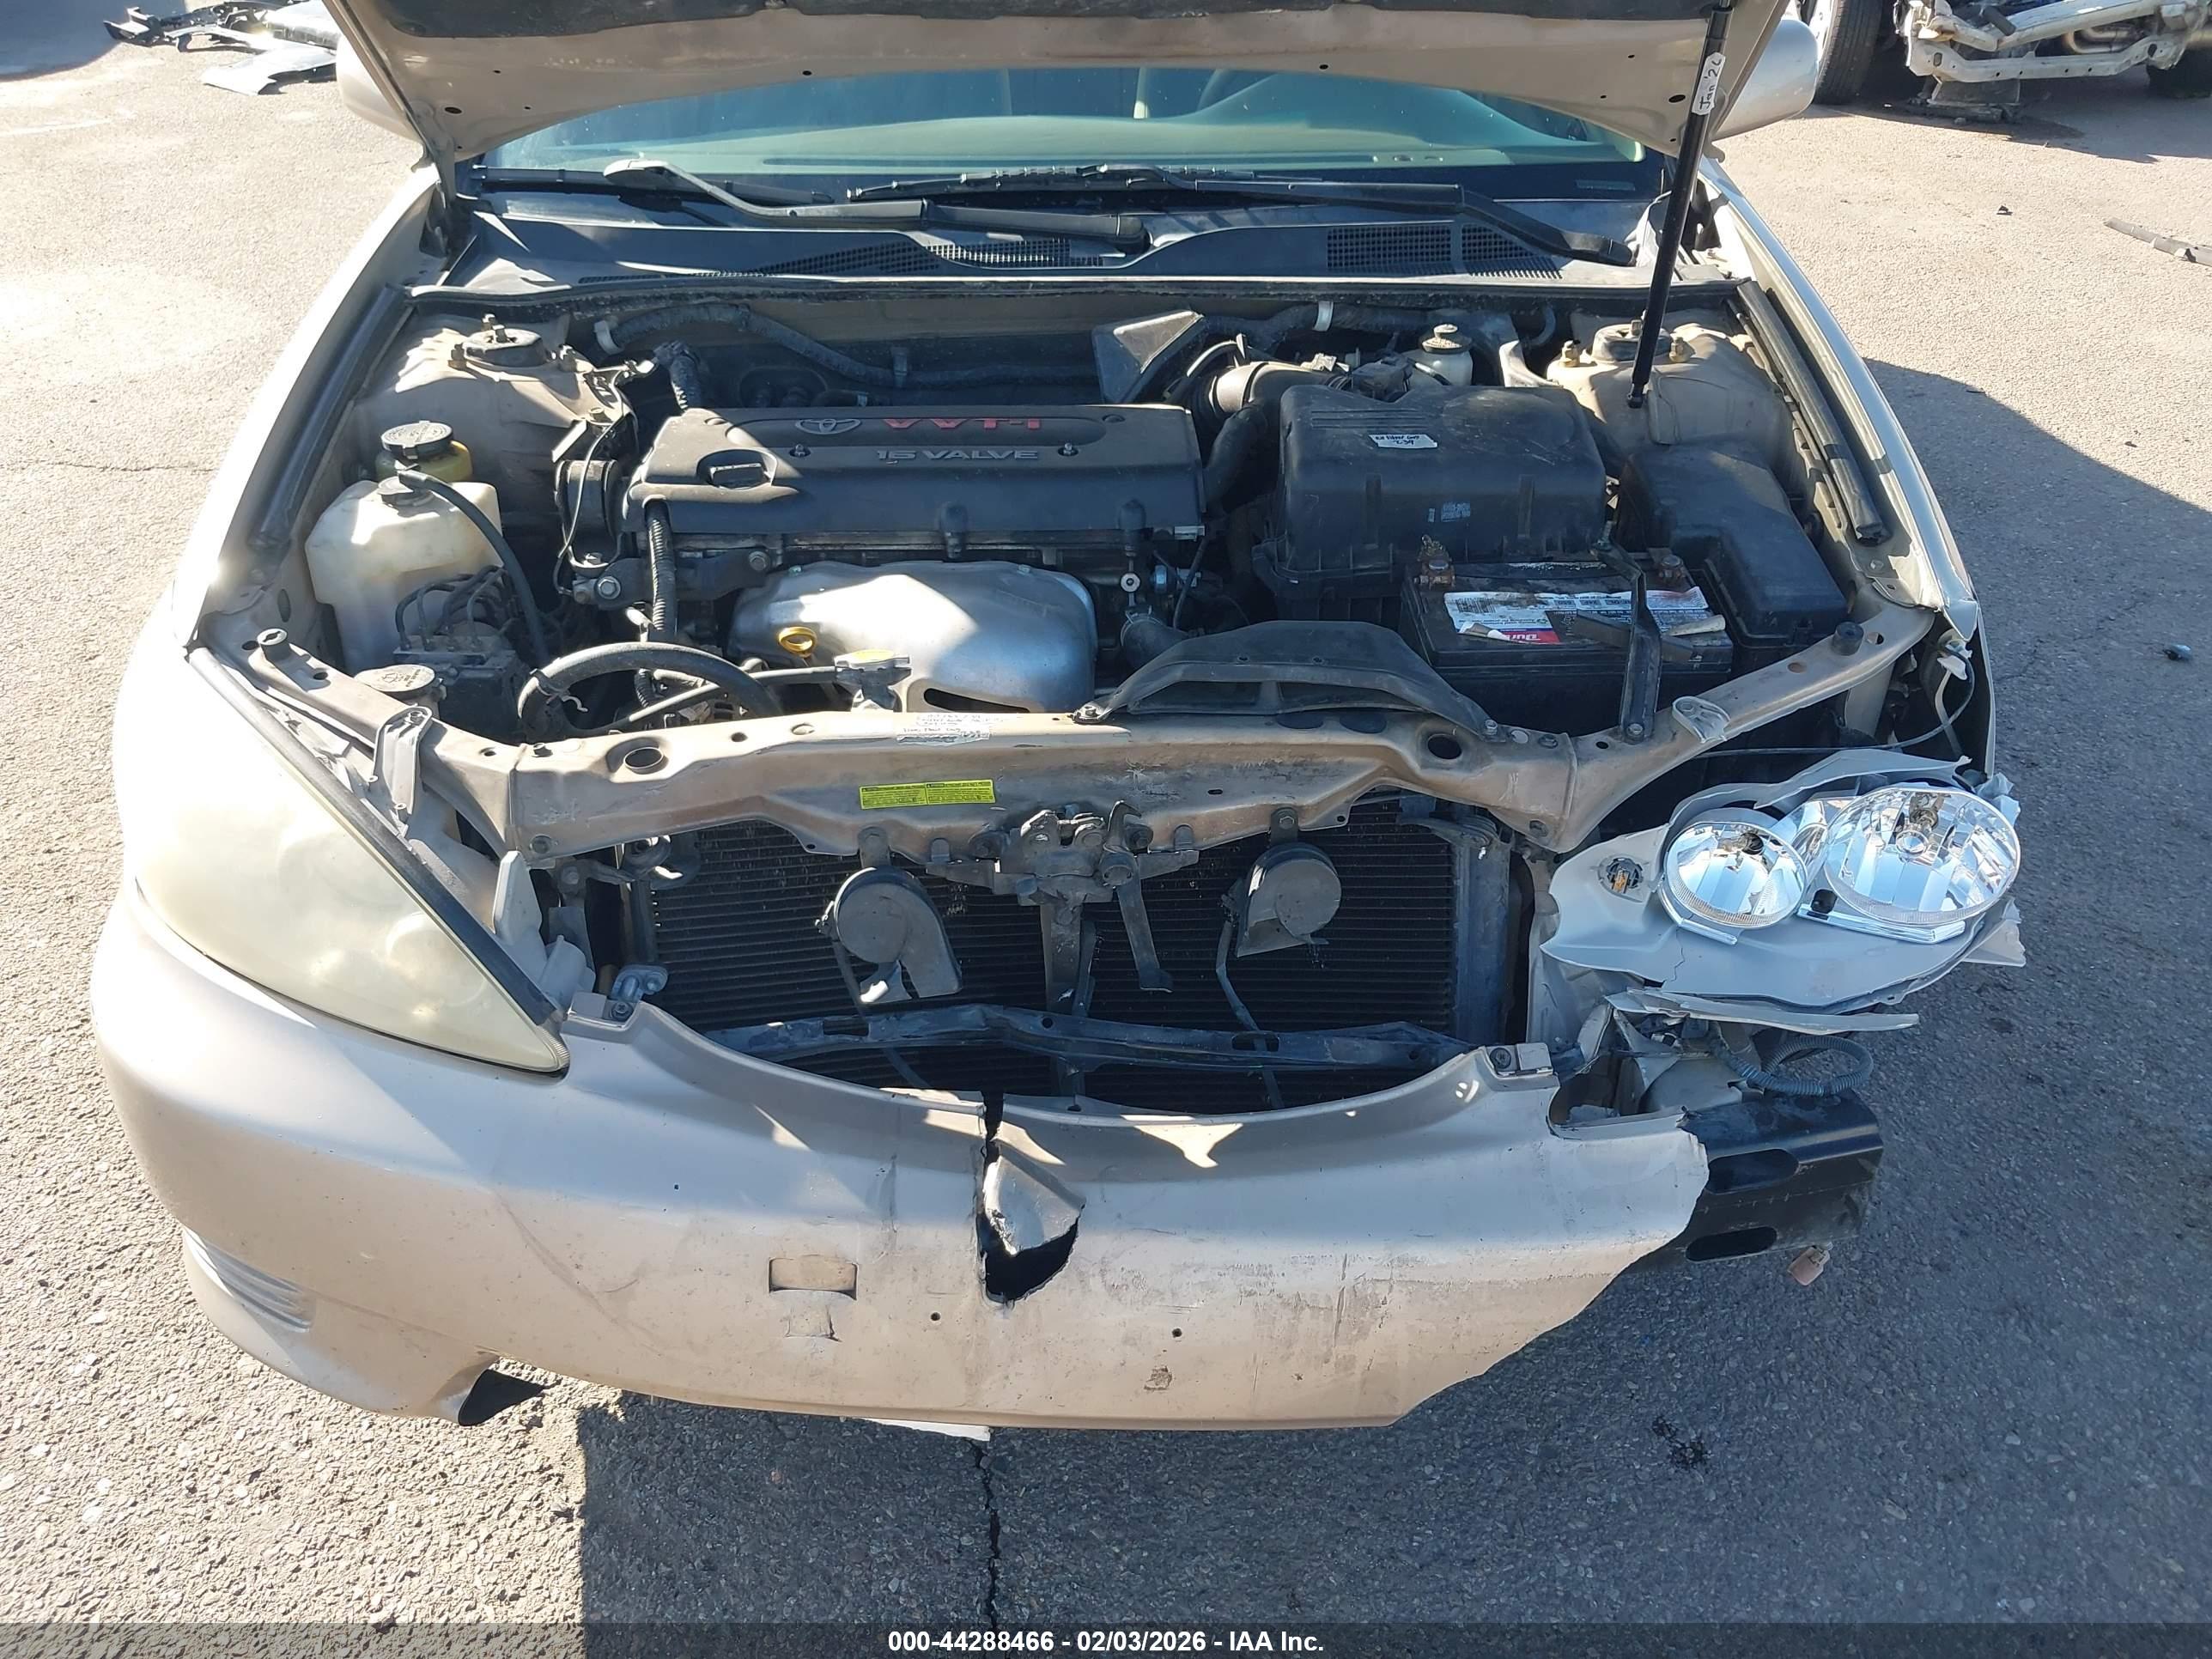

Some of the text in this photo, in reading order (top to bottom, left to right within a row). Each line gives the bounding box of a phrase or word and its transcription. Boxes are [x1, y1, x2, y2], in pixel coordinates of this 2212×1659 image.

[1699, 84, 1716, 110] Jan
[877, 450, 1038, 460] 16 VALVE
